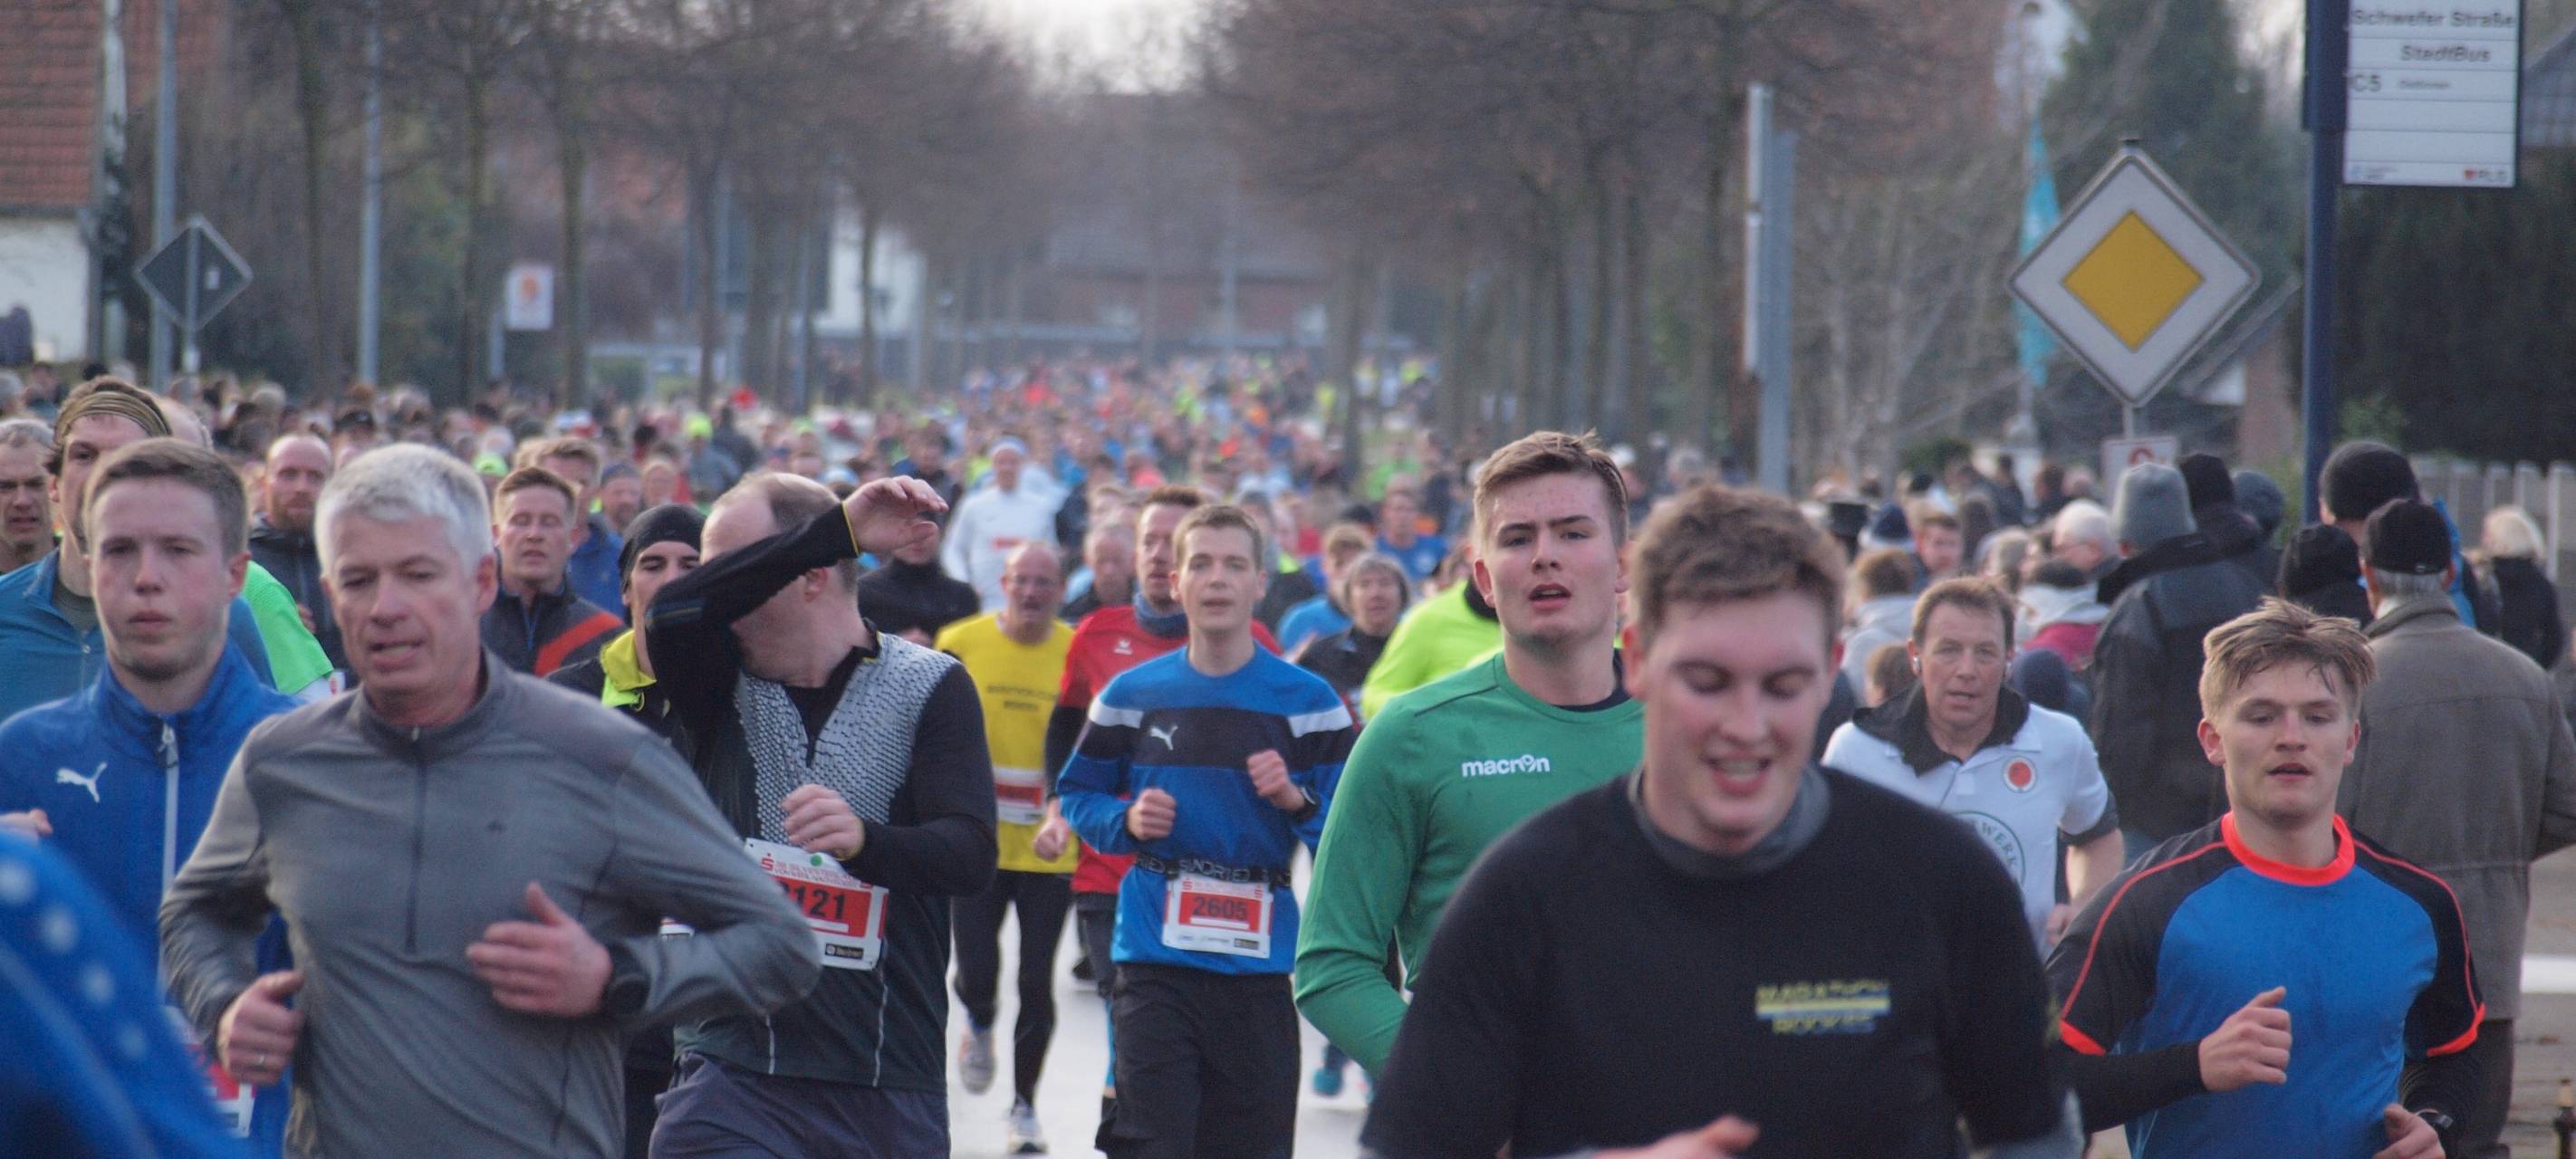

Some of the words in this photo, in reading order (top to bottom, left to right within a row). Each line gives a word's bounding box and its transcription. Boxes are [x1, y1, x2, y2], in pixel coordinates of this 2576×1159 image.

[2355, 9, 2445, 26] Schwefer
[2400, 45, 2490, 62] StadtBus
[1461, 754, 1551, 777] macron
[783, 881, 846, 921] 121
